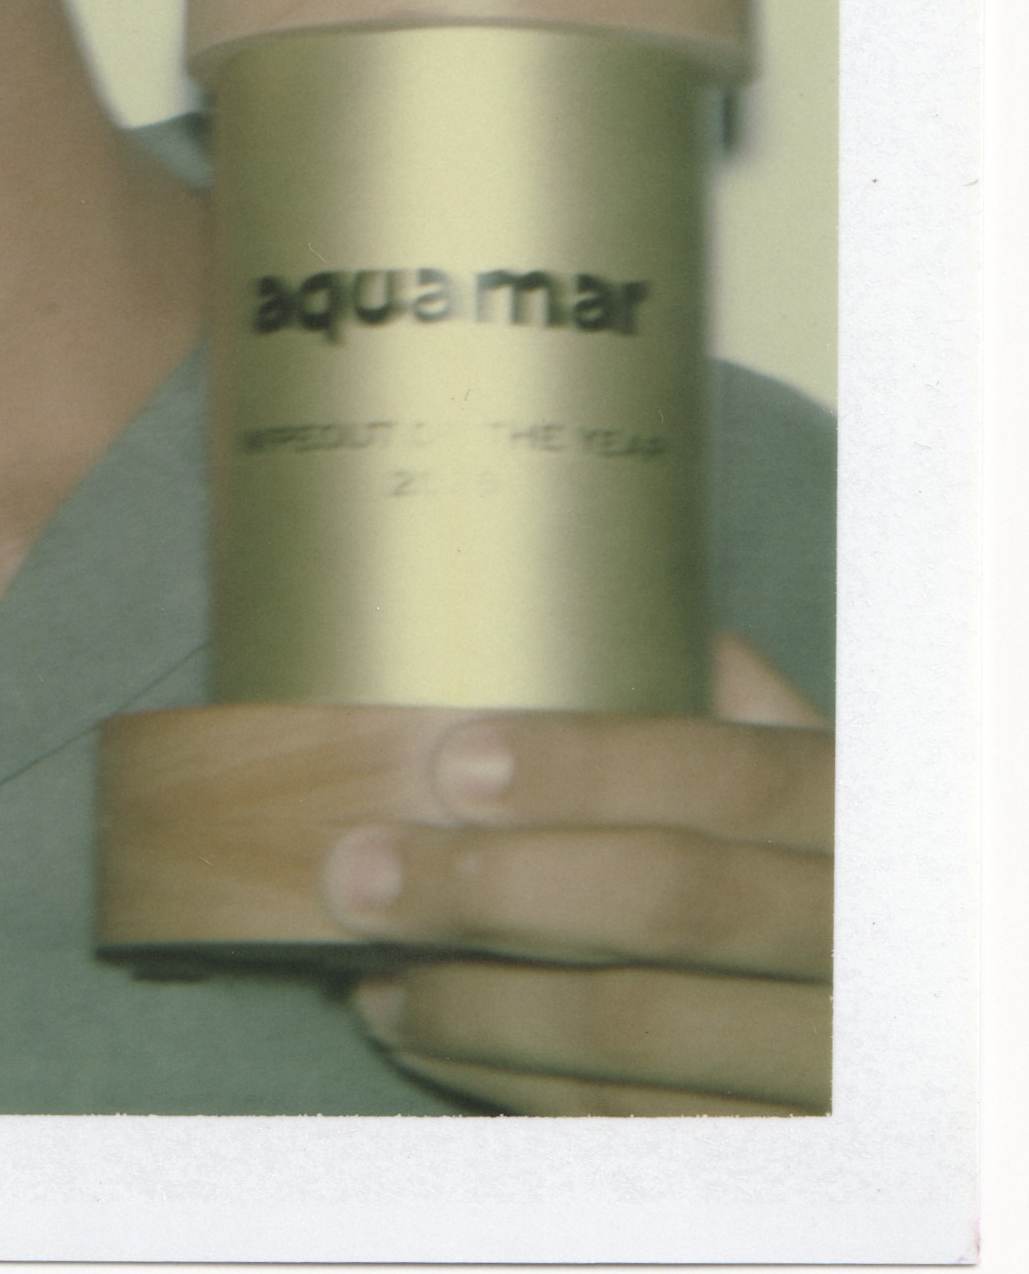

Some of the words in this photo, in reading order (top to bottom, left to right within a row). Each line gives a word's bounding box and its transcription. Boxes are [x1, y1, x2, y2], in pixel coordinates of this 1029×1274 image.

[254, 267, 648, 343] aquamar
[486, 421, 567, 453] THE
[578, 426, 668, 460] YEAR
